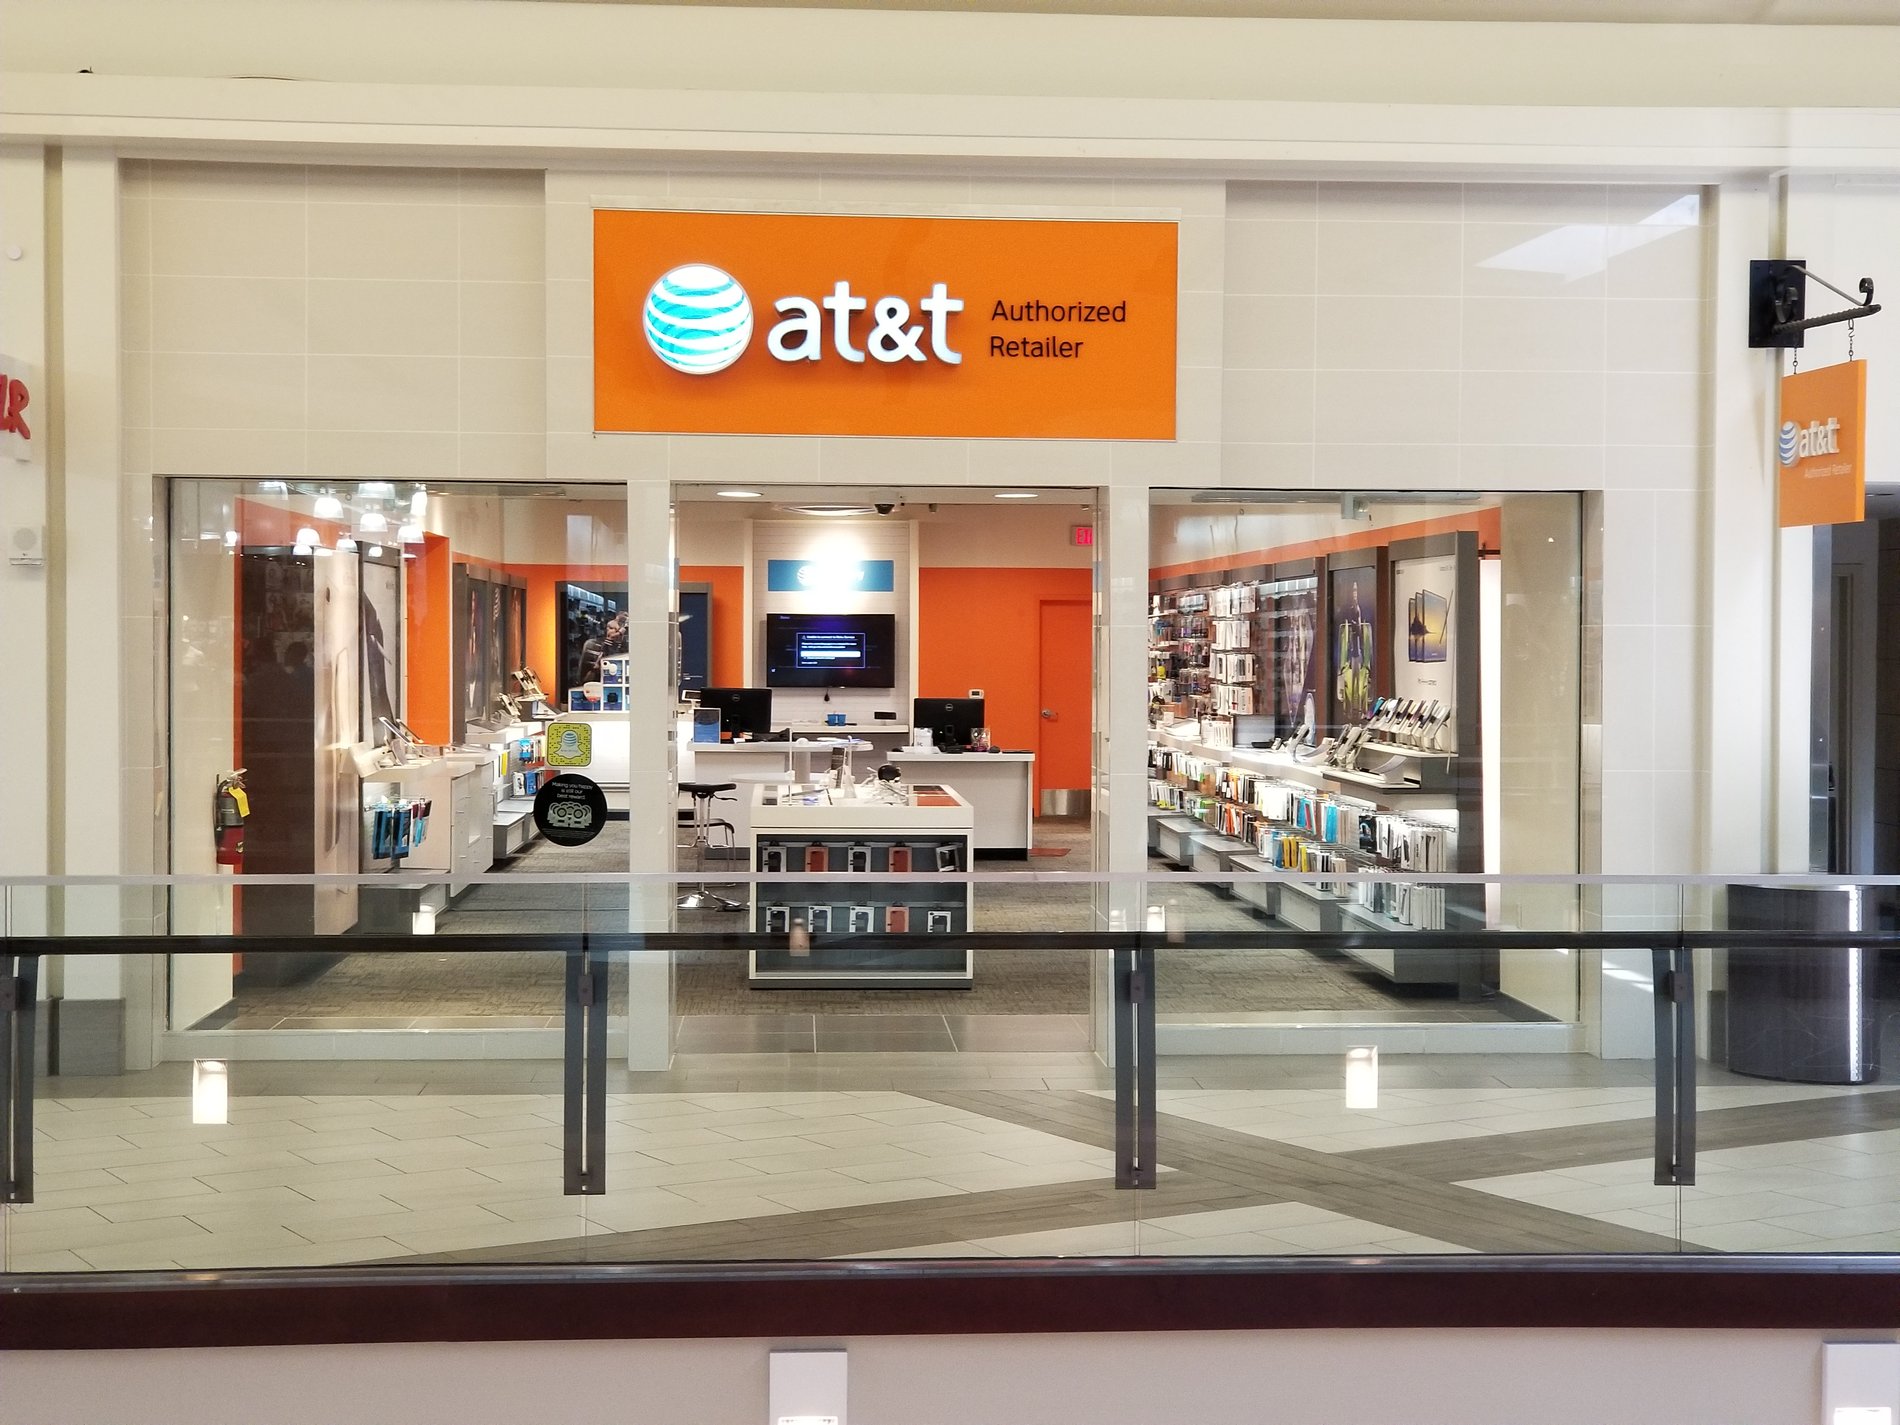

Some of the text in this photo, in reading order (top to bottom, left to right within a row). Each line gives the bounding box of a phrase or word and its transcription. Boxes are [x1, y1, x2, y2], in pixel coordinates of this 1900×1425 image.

[767, 280, 965, 366] at&t
[990, 299, 1127, 323] Authorized
[990, 334, 1085, 359] Retailer
[1799, 417, 1840, 457] at&t
